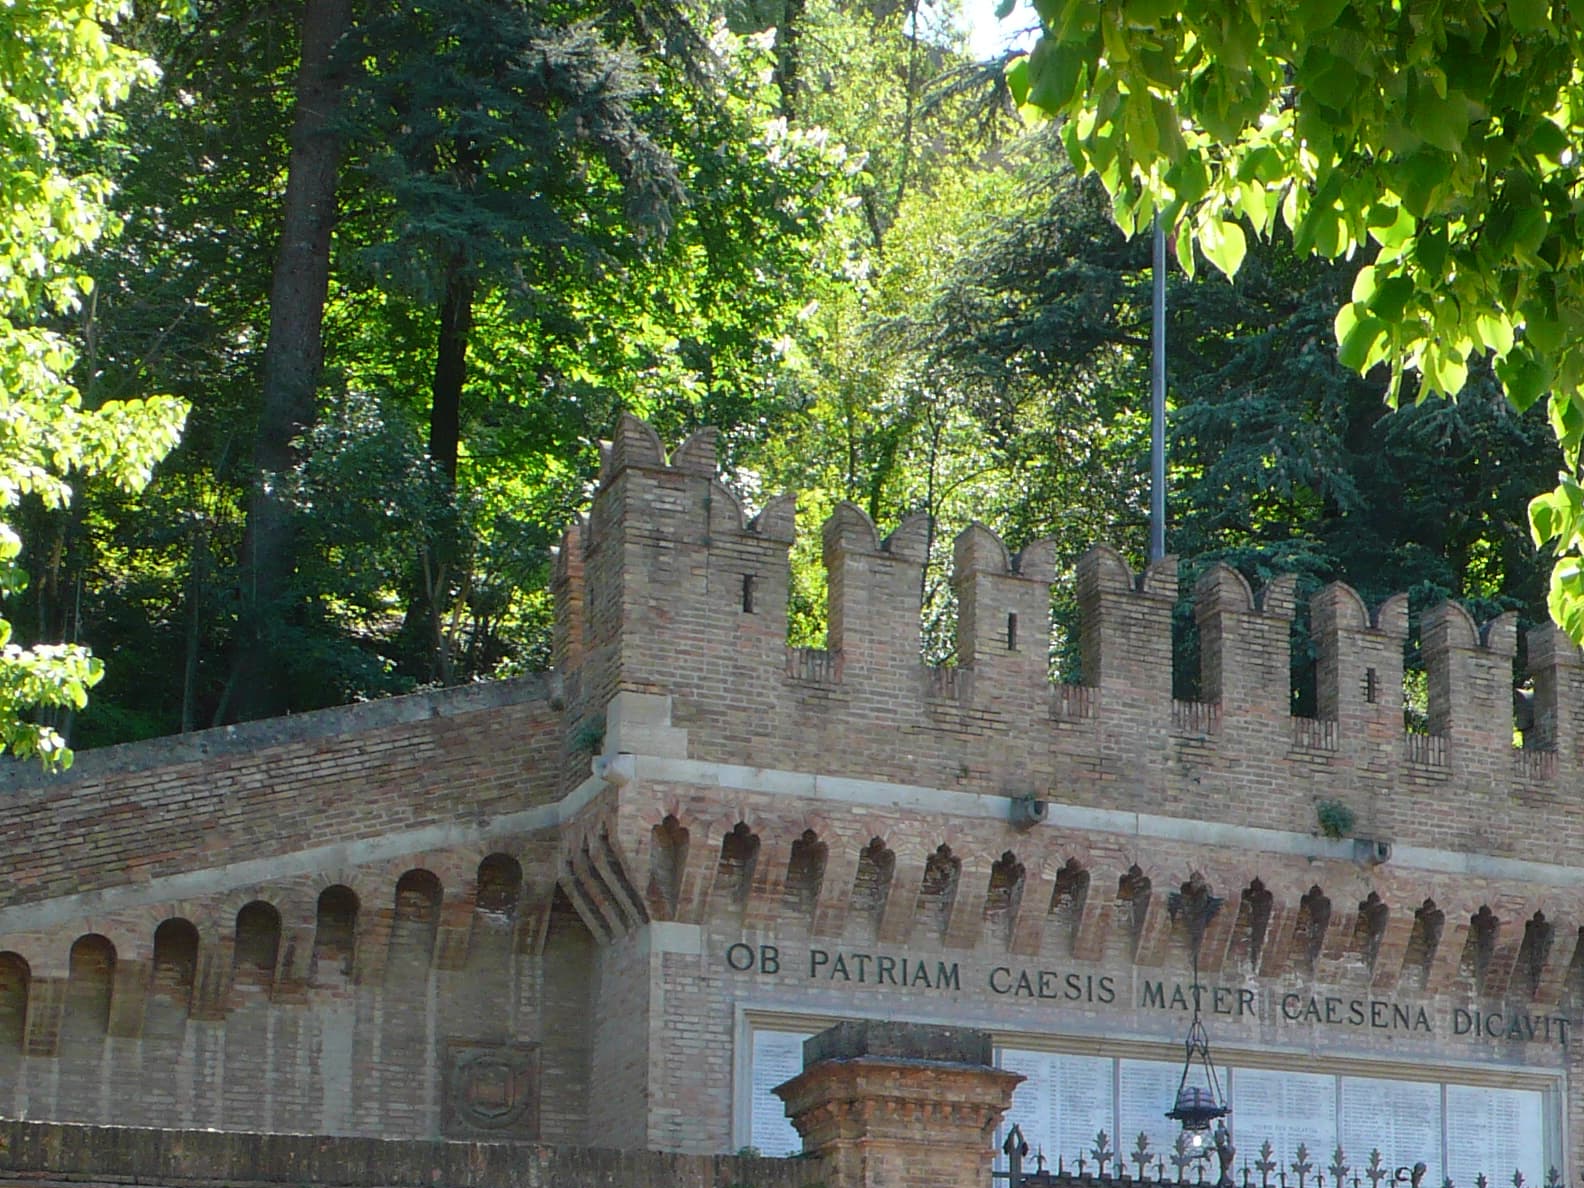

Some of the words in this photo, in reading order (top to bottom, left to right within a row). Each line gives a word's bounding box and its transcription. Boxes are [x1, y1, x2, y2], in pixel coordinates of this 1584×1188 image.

[727, 942, 780, 974] OB
[810, 949, 960, 991] PATRIAM
[989, 967, 1116, 1004] CAESIS
[1142, 980, 1256, 1017] MATER
[1281, 993, 1431, 1033] CAESENA
[1453, 1008, 1571, 1045] DICAVIT
